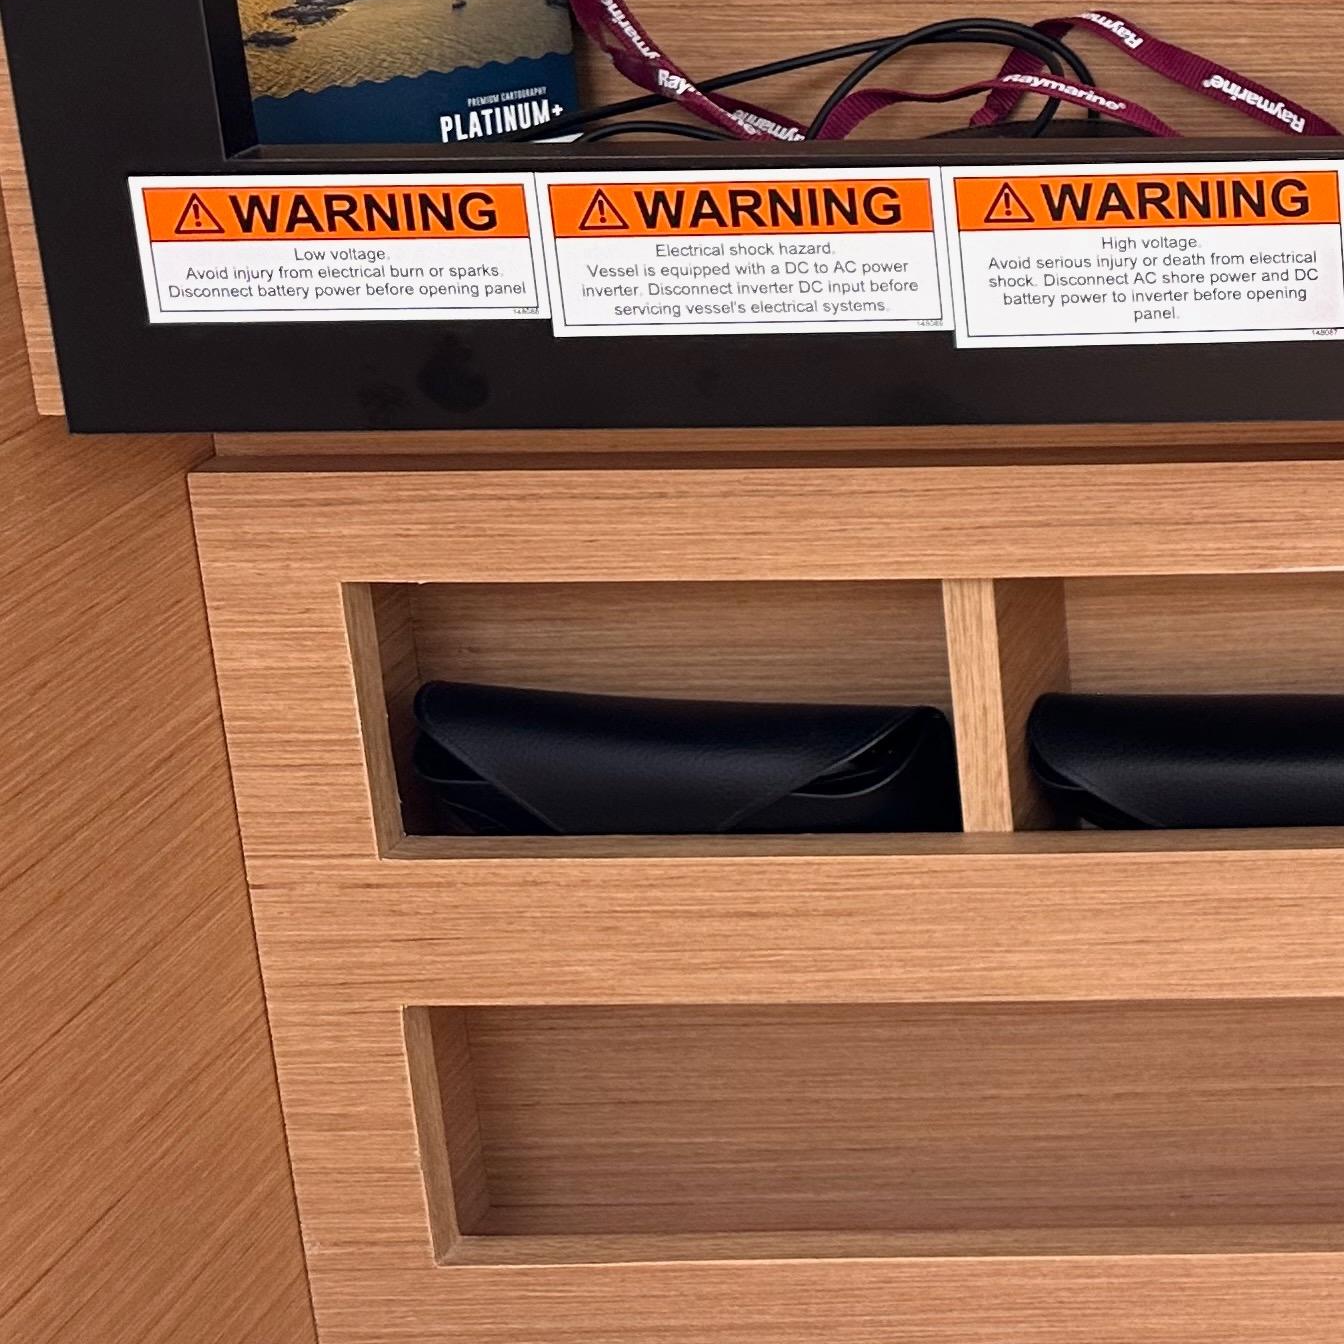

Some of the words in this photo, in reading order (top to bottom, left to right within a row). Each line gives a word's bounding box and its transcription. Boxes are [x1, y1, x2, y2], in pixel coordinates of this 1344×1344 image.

[467, 94, 500, 107] PREMIUM
[439, 99, 564, 143] PLATINUM+
[634, 187, 902, 229] WARNING
[1041, 179, 1310, 222] WARNING
[228, 191, 498, 235] WARNING
[656, 242, 724, 257] Electrical
[729, 242, 774, 257] shock
[779, 241, 836, 256] hazard.
[1102, 236, 1137, 252] High
[1141, 235, 1202, 253] voltage.
[294, 247, 326, 261] Low
[330, 247, 390, 264] voltage.
[988, 256, 1031, 271] Avoid
[1036, 255, 1092, 270] serious
[1097, 254, 1138, 272] injury
[1142, 256, 1158, 268] or
[1163, 252, 1206, 267] death
[1210, 252, 1246, 266] from
[1249, 250, 1317, 265] electrical
[186, 266, 228, 280] Avoid
[233, 266, 273, 283] injury
[279, 264, 313, 279] from
[318, 264, 386, 279] electrical
[390, 264, 425, 278] burn
[429, 267, 445, 278] or
[587, 263, 639, 279] Vessel
[644, 263, 656, 277] is
[660, 262, 731, 281] equipped
[735, 261, 766, 276] with
[771, 264, 781, 275] a
[786, 261, 810, 275] DC
[814, 261, 829, 274] to
[833, 260, 857, 274] AC
[862, 260, 909, 277] power
[988, 273, 1038, 289] shock.
[1044, 272, 1130, 287] Disconnect
[1133, 271, 1158, 286] AC
[1162, 270, 1205, 285] shore
[1210, 271, 1258, 287] power
[1261, 268, 1290, 283] and
[1295, 267, 1320, 282] DC
[169, 283, 254, 298] Disconnect
[258, 283, 309, 301] battery
[315, 286, 361, 301] power
[366, 282, 414, 297] before
[419, 283, 479, 300] opening
[484, 282, 526, 298] panel
[649, 281, 733, 297] Disconnect
[737, 281, 793, 295] inverter
[799, 281, 823, 295] DC
[828, 280, 866, 297] input
[869, 278, 919, 293] before
[1003, 290, 1056, 308] battery
[1060, 291, 1108, 306] power
[1112, 289, 1127, 303] to
[1132, 287, 1189, 303] inverter
[1192, 286, 1242, 301] before
[1247, 286, 1307, 304] opening
[614, 301, 681, 319] servicing
[685, 300, 747, 316] vessel's
[751, 299, 818, 314] electrical
[1134, 306, 1181, 323] panel.
